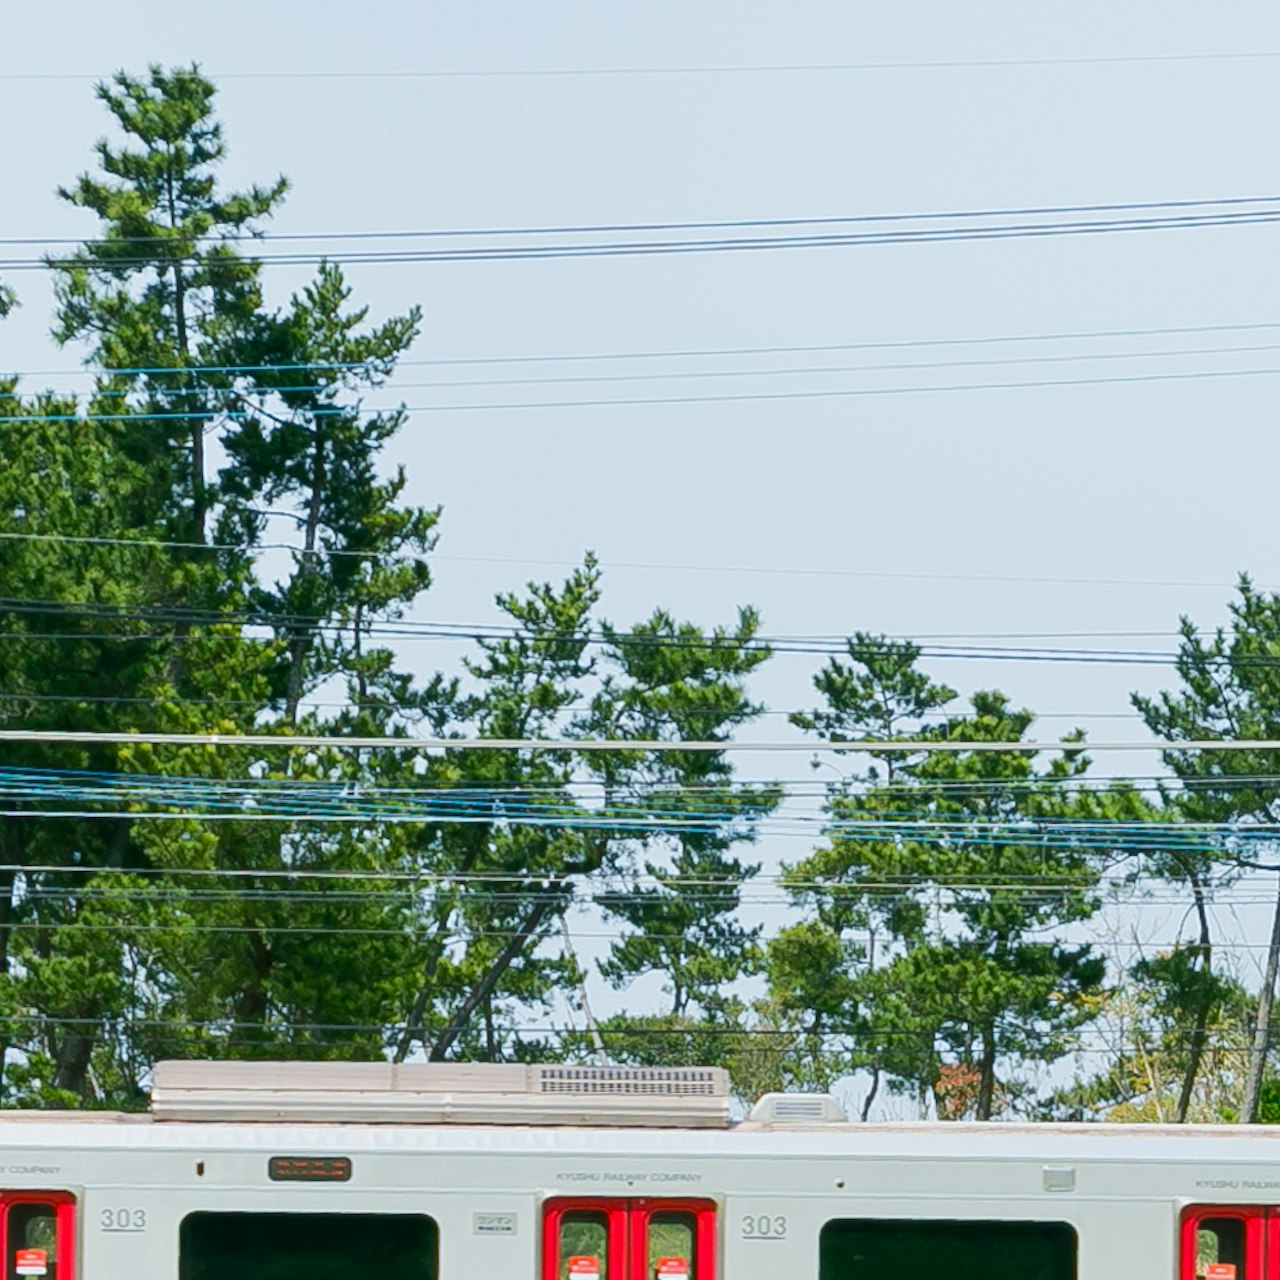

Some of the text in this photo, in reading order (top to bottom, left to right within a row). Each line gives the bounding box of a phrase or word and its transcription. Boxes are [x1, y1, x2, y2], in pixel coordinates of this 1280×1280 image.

[8, 1165, 62, 1174] COMPANY
[556, 1172, 703, 1182] KYUSHU RAILWAY COMPANY
[1195, 1180, 1239, 1189] KYUSHU
[100, 1208, 147, 1228] 303
[741, 1215, 787, 1236] 303
